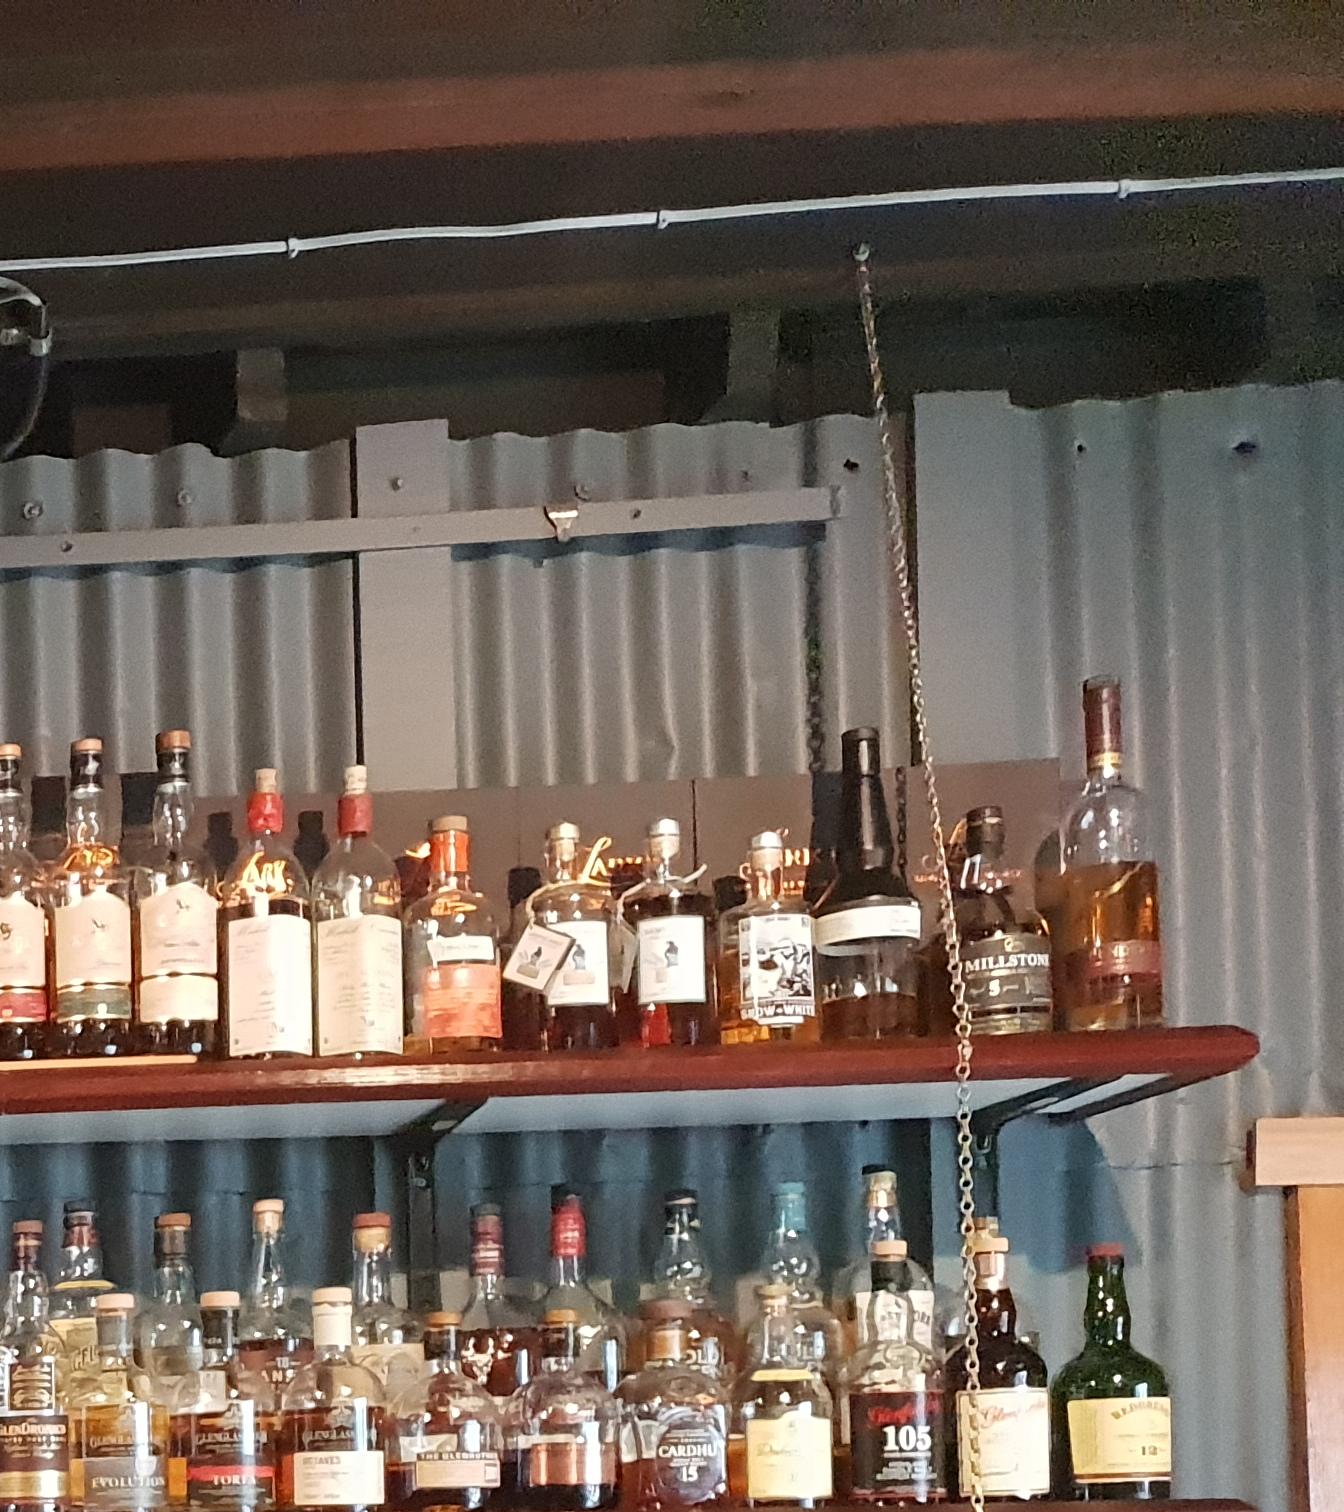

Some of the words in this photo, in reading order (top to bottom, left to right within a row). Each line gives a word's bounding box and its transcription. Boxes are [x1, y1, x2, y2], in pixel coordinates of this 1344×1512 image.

[883, 1425, 931, 1451] 105
[659, 1445, 718, 1459] CARDHU
[681, 1466, 699, 1482] 15
